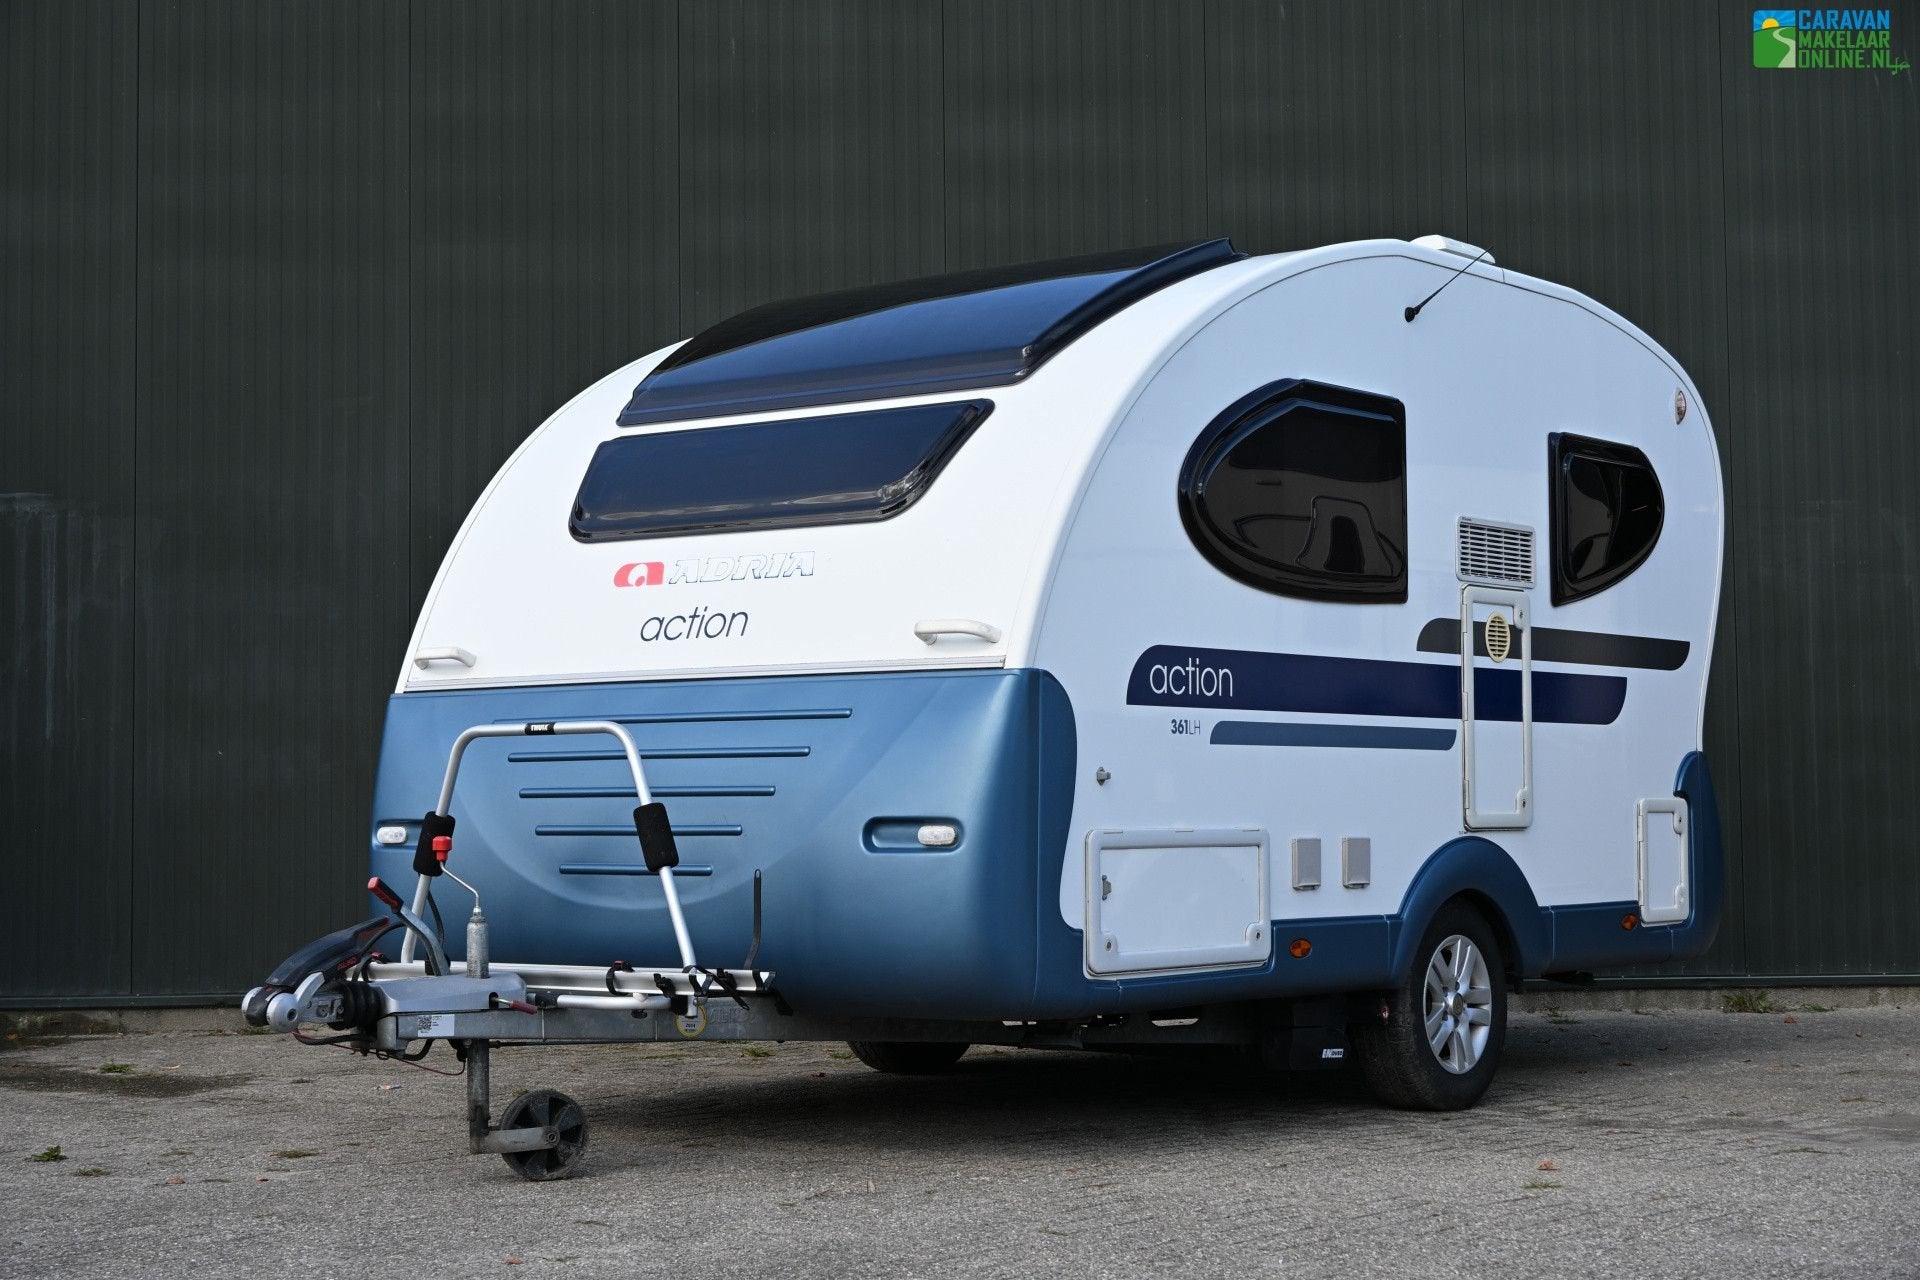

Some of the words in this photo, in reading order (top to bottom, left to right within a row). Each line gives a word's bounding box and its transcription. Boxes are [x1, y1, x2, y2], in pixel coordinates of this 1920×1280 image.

[668, 551, 815, 584] ADRIA
[640, 606, 749, 642] action
[1150, 657, 1233, 697] action
[1171, 718, 1201, 735] 361LH
